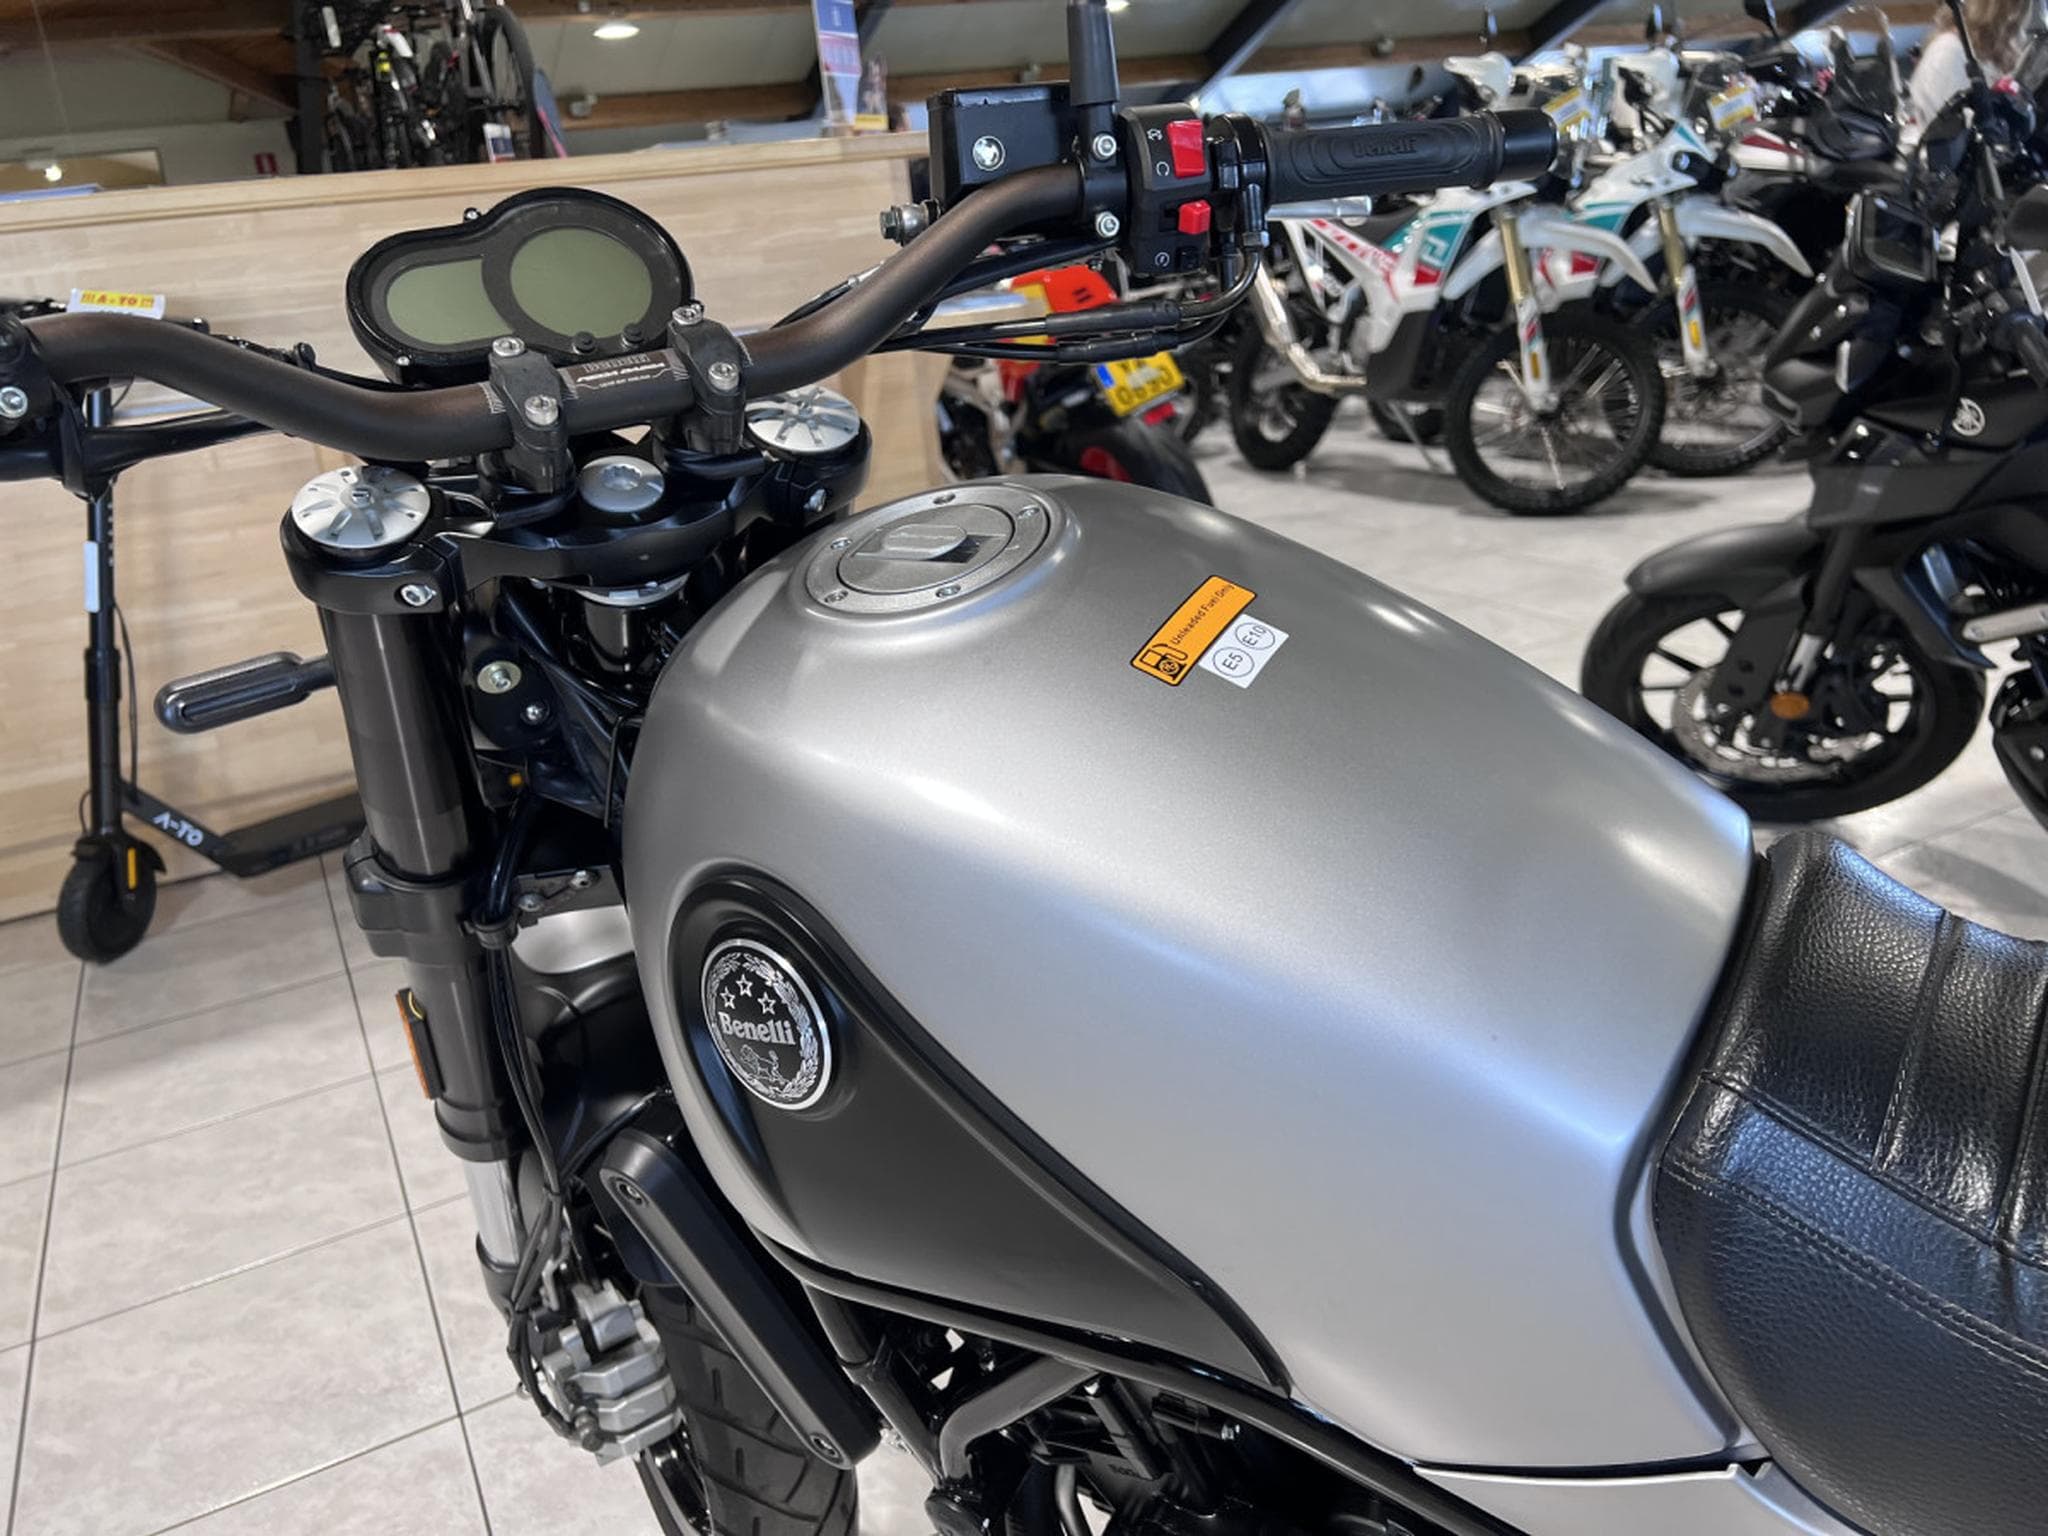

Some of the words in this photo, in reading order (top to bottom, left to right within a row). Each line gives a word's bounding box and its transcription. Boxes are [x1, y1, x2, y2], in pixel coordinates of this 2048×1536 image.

[1172, 607, 1206, 644] Unleaded
[1202, 592, 1220, 613] Fuel
[1242, 624, 1267, 646] E10
[1222, 652, 1244, 671] E5
[153, 811, 204, 847] A-TO
[718, 1011, 796, 1045] Benelli
